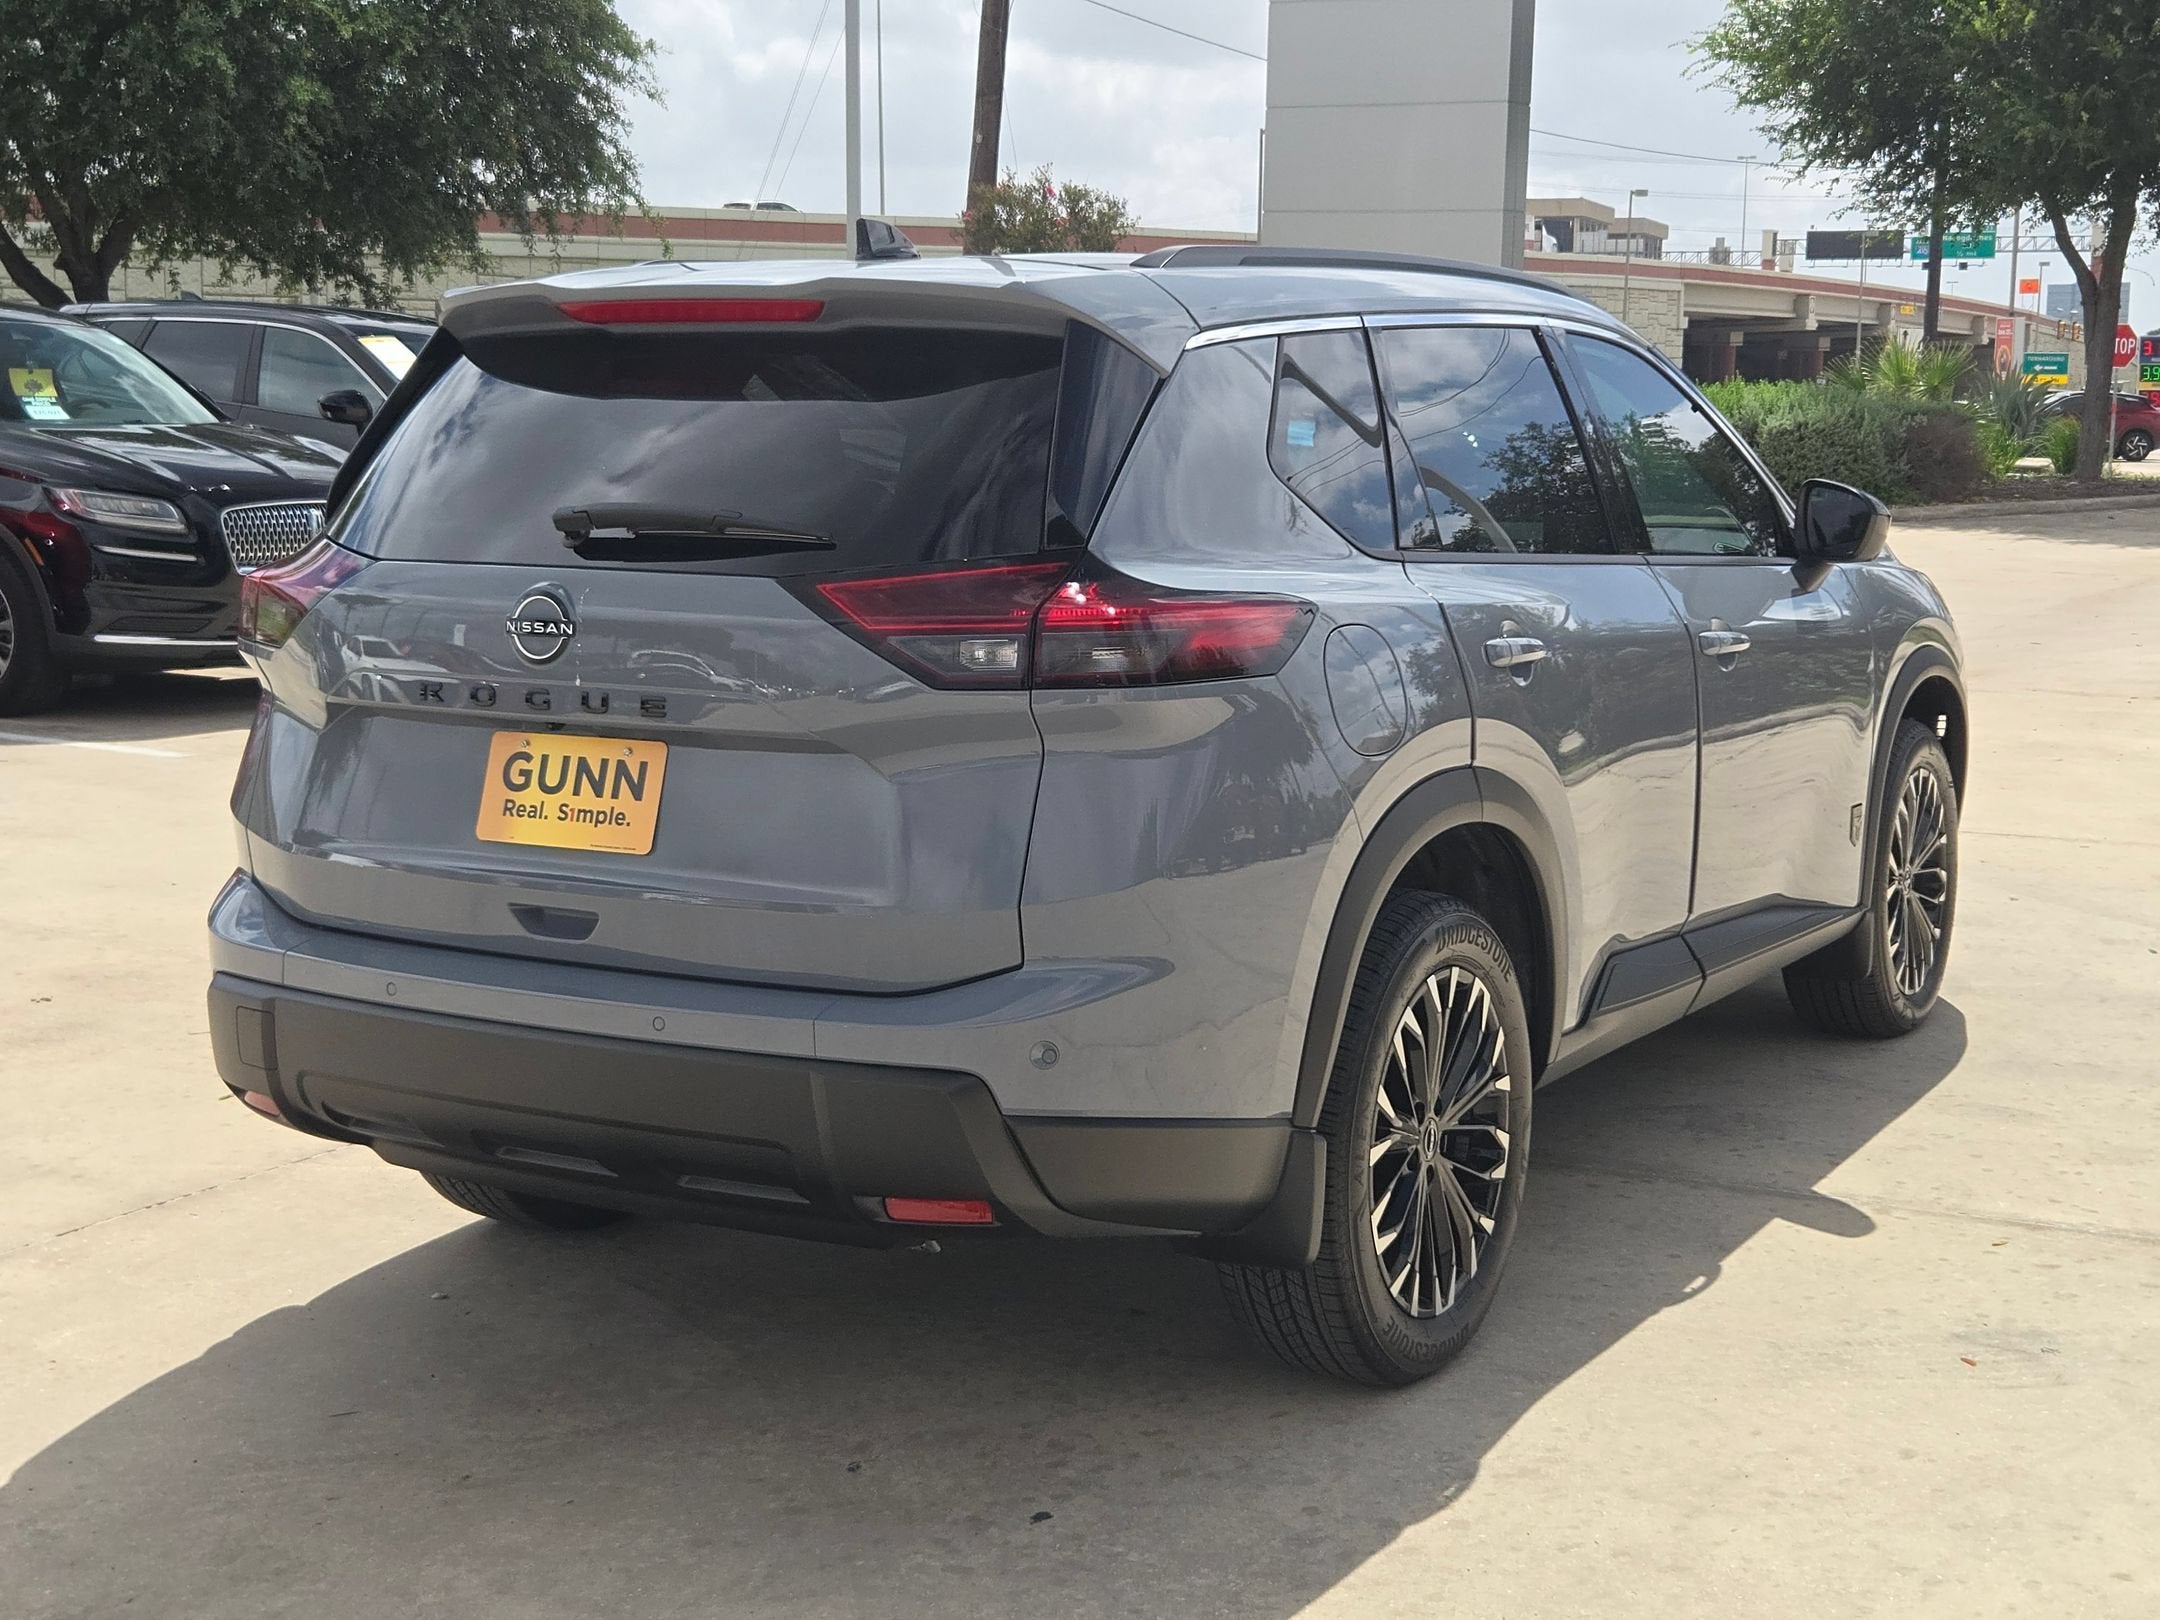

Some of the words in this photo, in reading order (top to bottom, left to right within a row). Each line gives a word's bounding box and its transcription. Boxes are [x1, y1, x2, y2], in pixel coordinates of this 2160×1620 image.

[506, 620, 573, 636] NISSAN
[419, 681, 667, 718] ROGUE
[502, 750, 649, 802] GUNN
[502, 798, 548, 821] Real.
[1434, 924, 1512, 983] BRIDGESTONE
